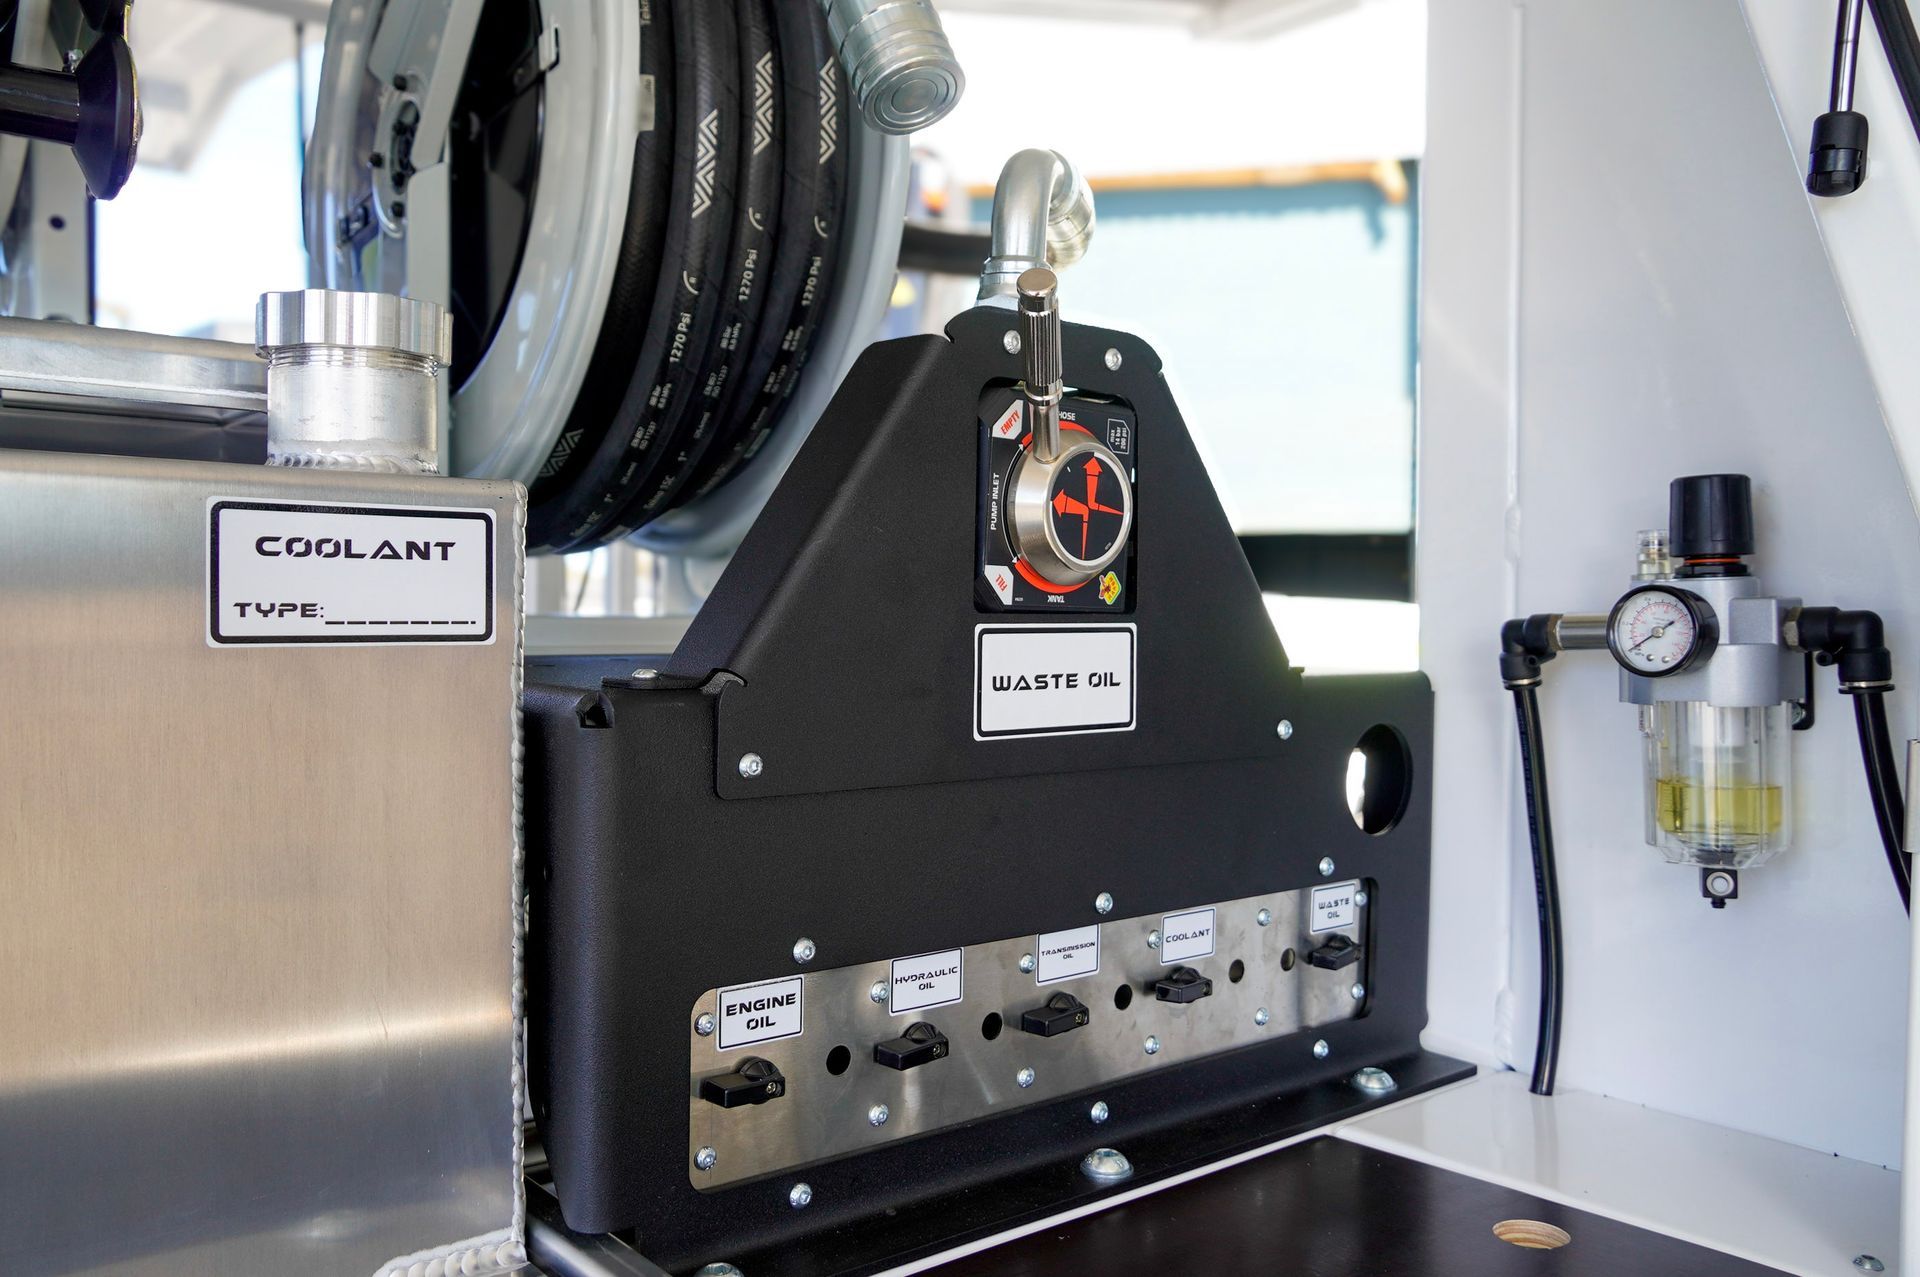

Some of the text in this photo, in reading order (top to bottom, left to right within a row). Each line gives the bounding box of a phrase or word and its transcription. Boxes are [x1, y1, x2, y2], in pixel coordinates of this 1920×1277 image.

[738, 249, 758, 302] 1270 Psi
[802, 276, 817, 306] 1270
[669, 311, 692, 363] 1270 Psi
[1000, 410, 1021, 435] EMPTY
[990, 473, 1000, 531] PUMP INLET
[255, 536, 456, 561] COOLANT
[996, 574, 1007, 591] FILL
[1047, 594, 1065, 604] TANK
[233, 602, 325, 618] TYPE:
[992, 671, 1121, 692] WASTE OIL
[1318, 897, 1350, 909] WASTE
[1327, 910, 1340, 919] OIL
[1165, 928, 1211, 943] COOLANT
[1041, 941, 1096, 957] TRANSMISSION
[1062, 952, 1074, 960] OIL
[895, 966, 958, 985] HYDRAULIC
[918, 981, 935, 991] OIL
[726, 993, 796, 1017] ENGINE
[746, 1017, 776, 1031] OIL
